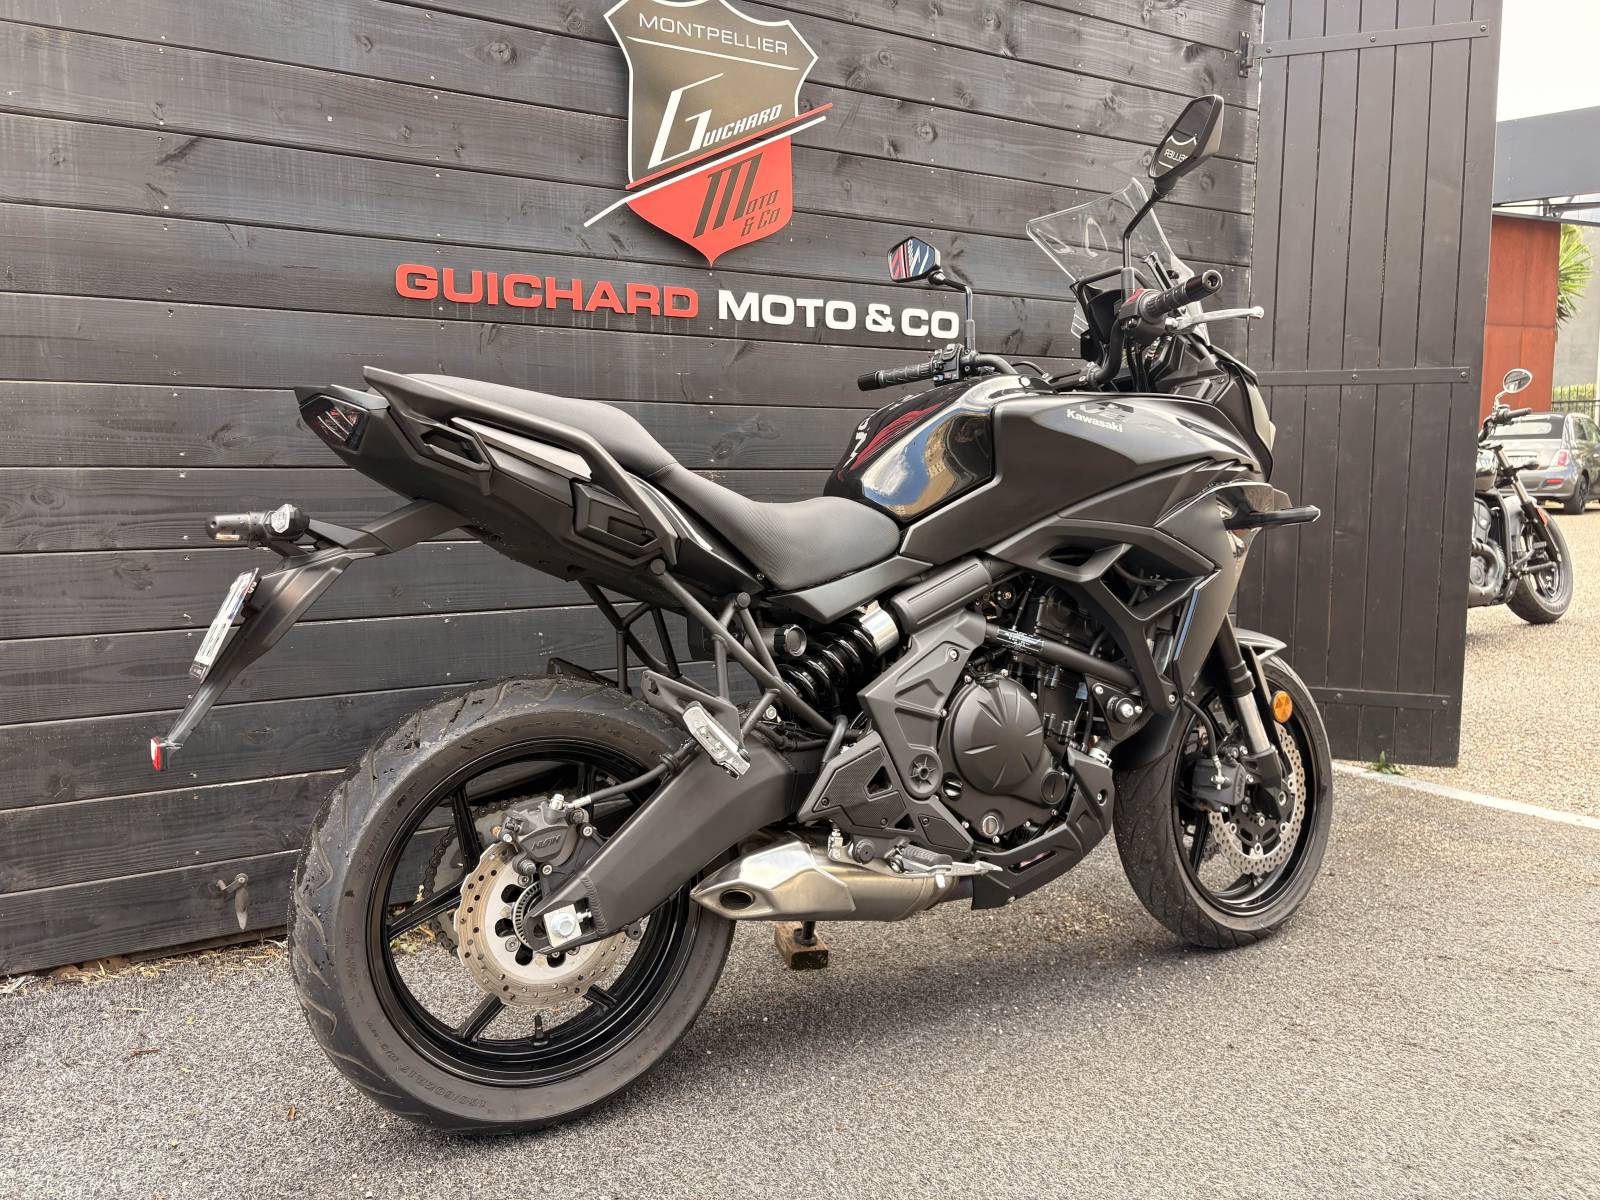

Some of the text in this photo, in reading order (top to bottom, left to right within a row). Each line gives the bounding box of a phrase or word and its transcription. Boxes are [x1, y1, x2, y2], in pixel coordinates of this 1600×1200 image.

[638, 13, 789, 55] MONTPELLIER
[757, 208, 781, 231] CO
[395, 263, 960, 339] GUICHARD MOTO & CO
[1066, 408, 1123, 433] Kawasaki
